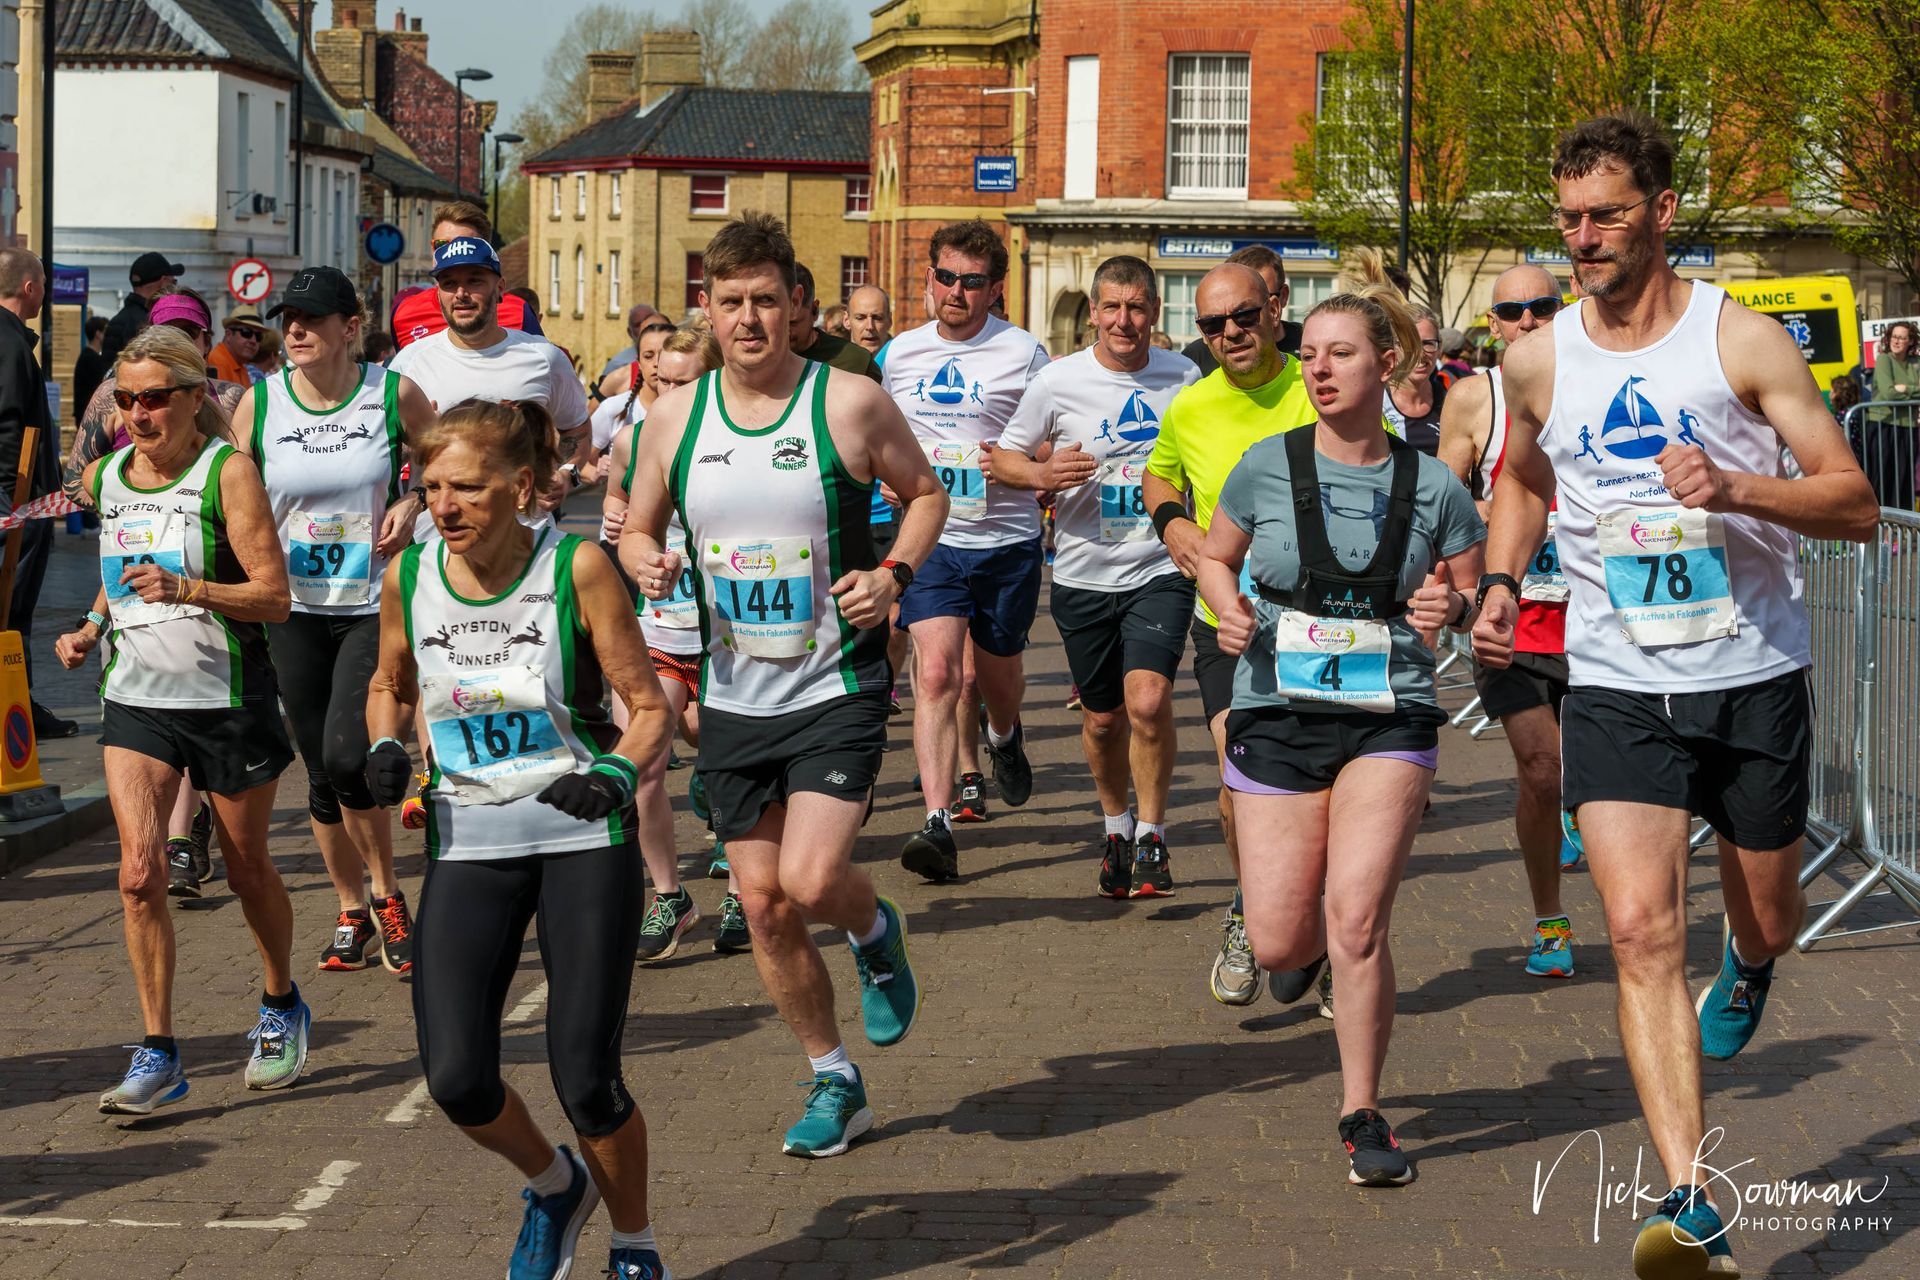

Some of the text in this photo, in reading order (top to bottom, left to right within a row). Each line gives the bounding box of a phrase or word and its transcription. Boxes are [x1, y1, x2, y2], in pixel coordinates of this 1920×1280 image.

[1165, 240, 1233, 254] BETFRED
[1737, 291, 1796, 307] LANCE
[303, 424, 347, 435] RYSTON
[302, 442, 347, 453] RUNNERS
[772, 459, 807, 471] RUNNERS
[934, 466, 968, 496] 91
[1629, 485, 1668, 499] Norfolk
[119, 503, 163, 513] RYSTON
[1640, 535, 1678, 543] FAKENHAM
[307, 543, 345, 577] 59
[1637, 553, 1693, 603] 78
[729, 579, 795, 622] 144
[1322, 599, 1372, 610] RUNITUDE
[1624, 606, 1718, 623] Get Active in Fakenham
[450, 620, 512, 636] RYSTON
[740, 627, 757, 637] Active
[758, 629, 765, 637] in
[766, 627, 803, 637] Fakenham
[3, 653, 23, 666] POLICE
[448, 649, 510, 666] RUNNERS
[1320, 654, 1343, 691] 4
[1342, 692, 1380, 700] Fakenham
[457, 711, 540, 766] 162
